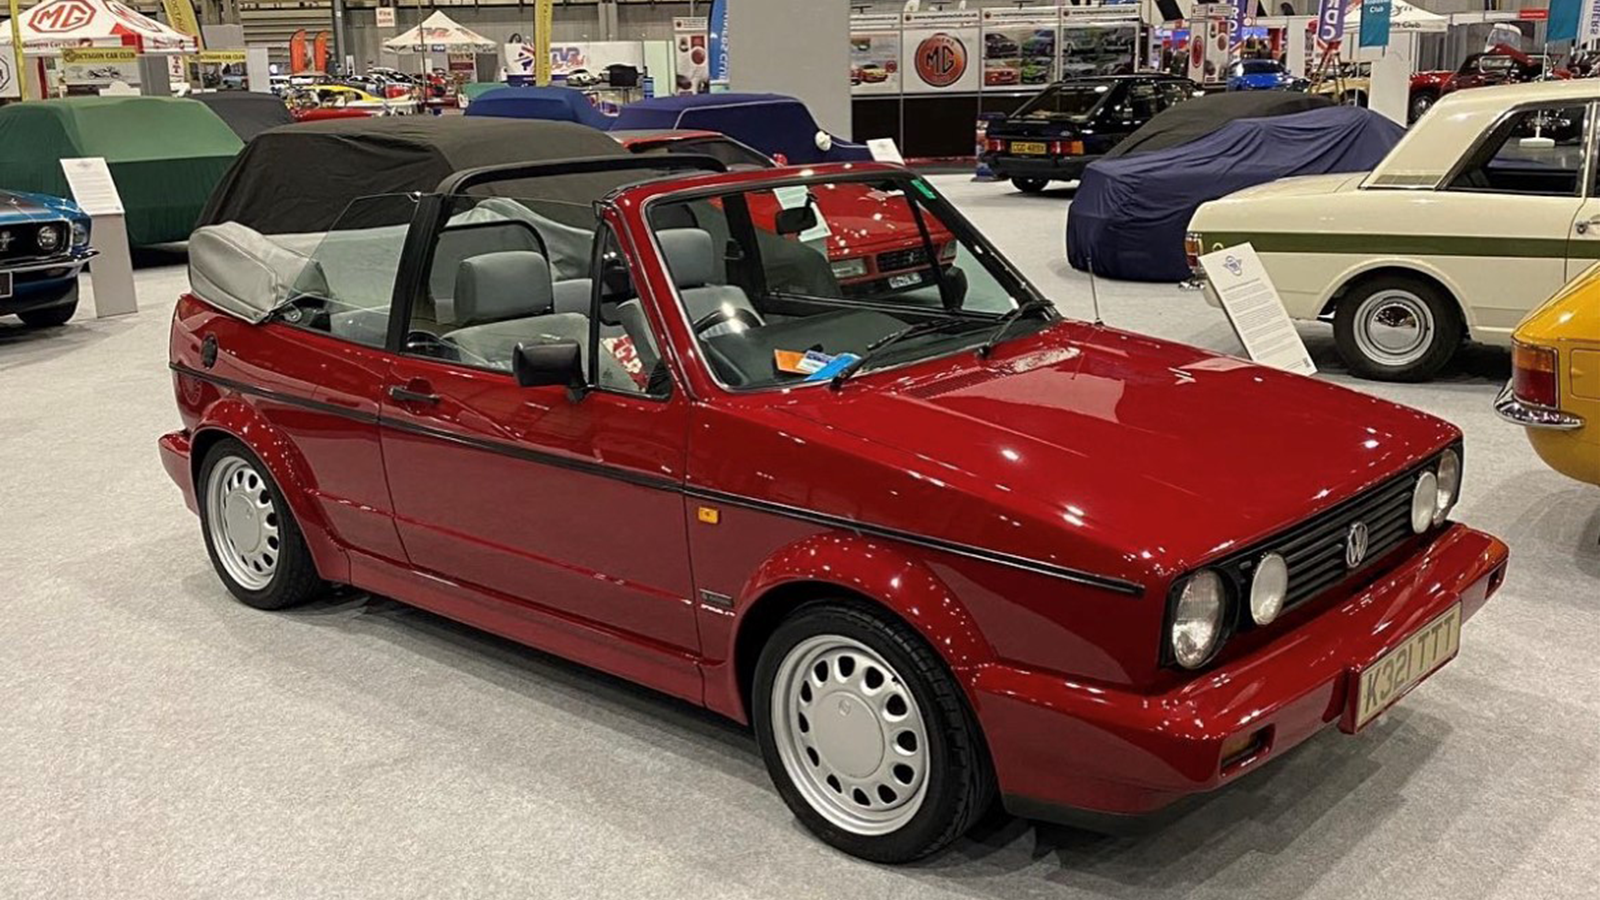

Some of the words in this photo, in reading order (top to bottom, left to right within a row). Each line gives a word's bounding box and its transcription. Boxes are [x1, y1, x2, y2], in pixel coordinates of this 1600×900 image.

[37, 4, 87, 28] MG
[119, 51, 136, 59] CLUB
[926, 46, 954, 74] MG
[1364, 643, 1414, 714] K321
[1418, 615, 1455, 671] TTT
